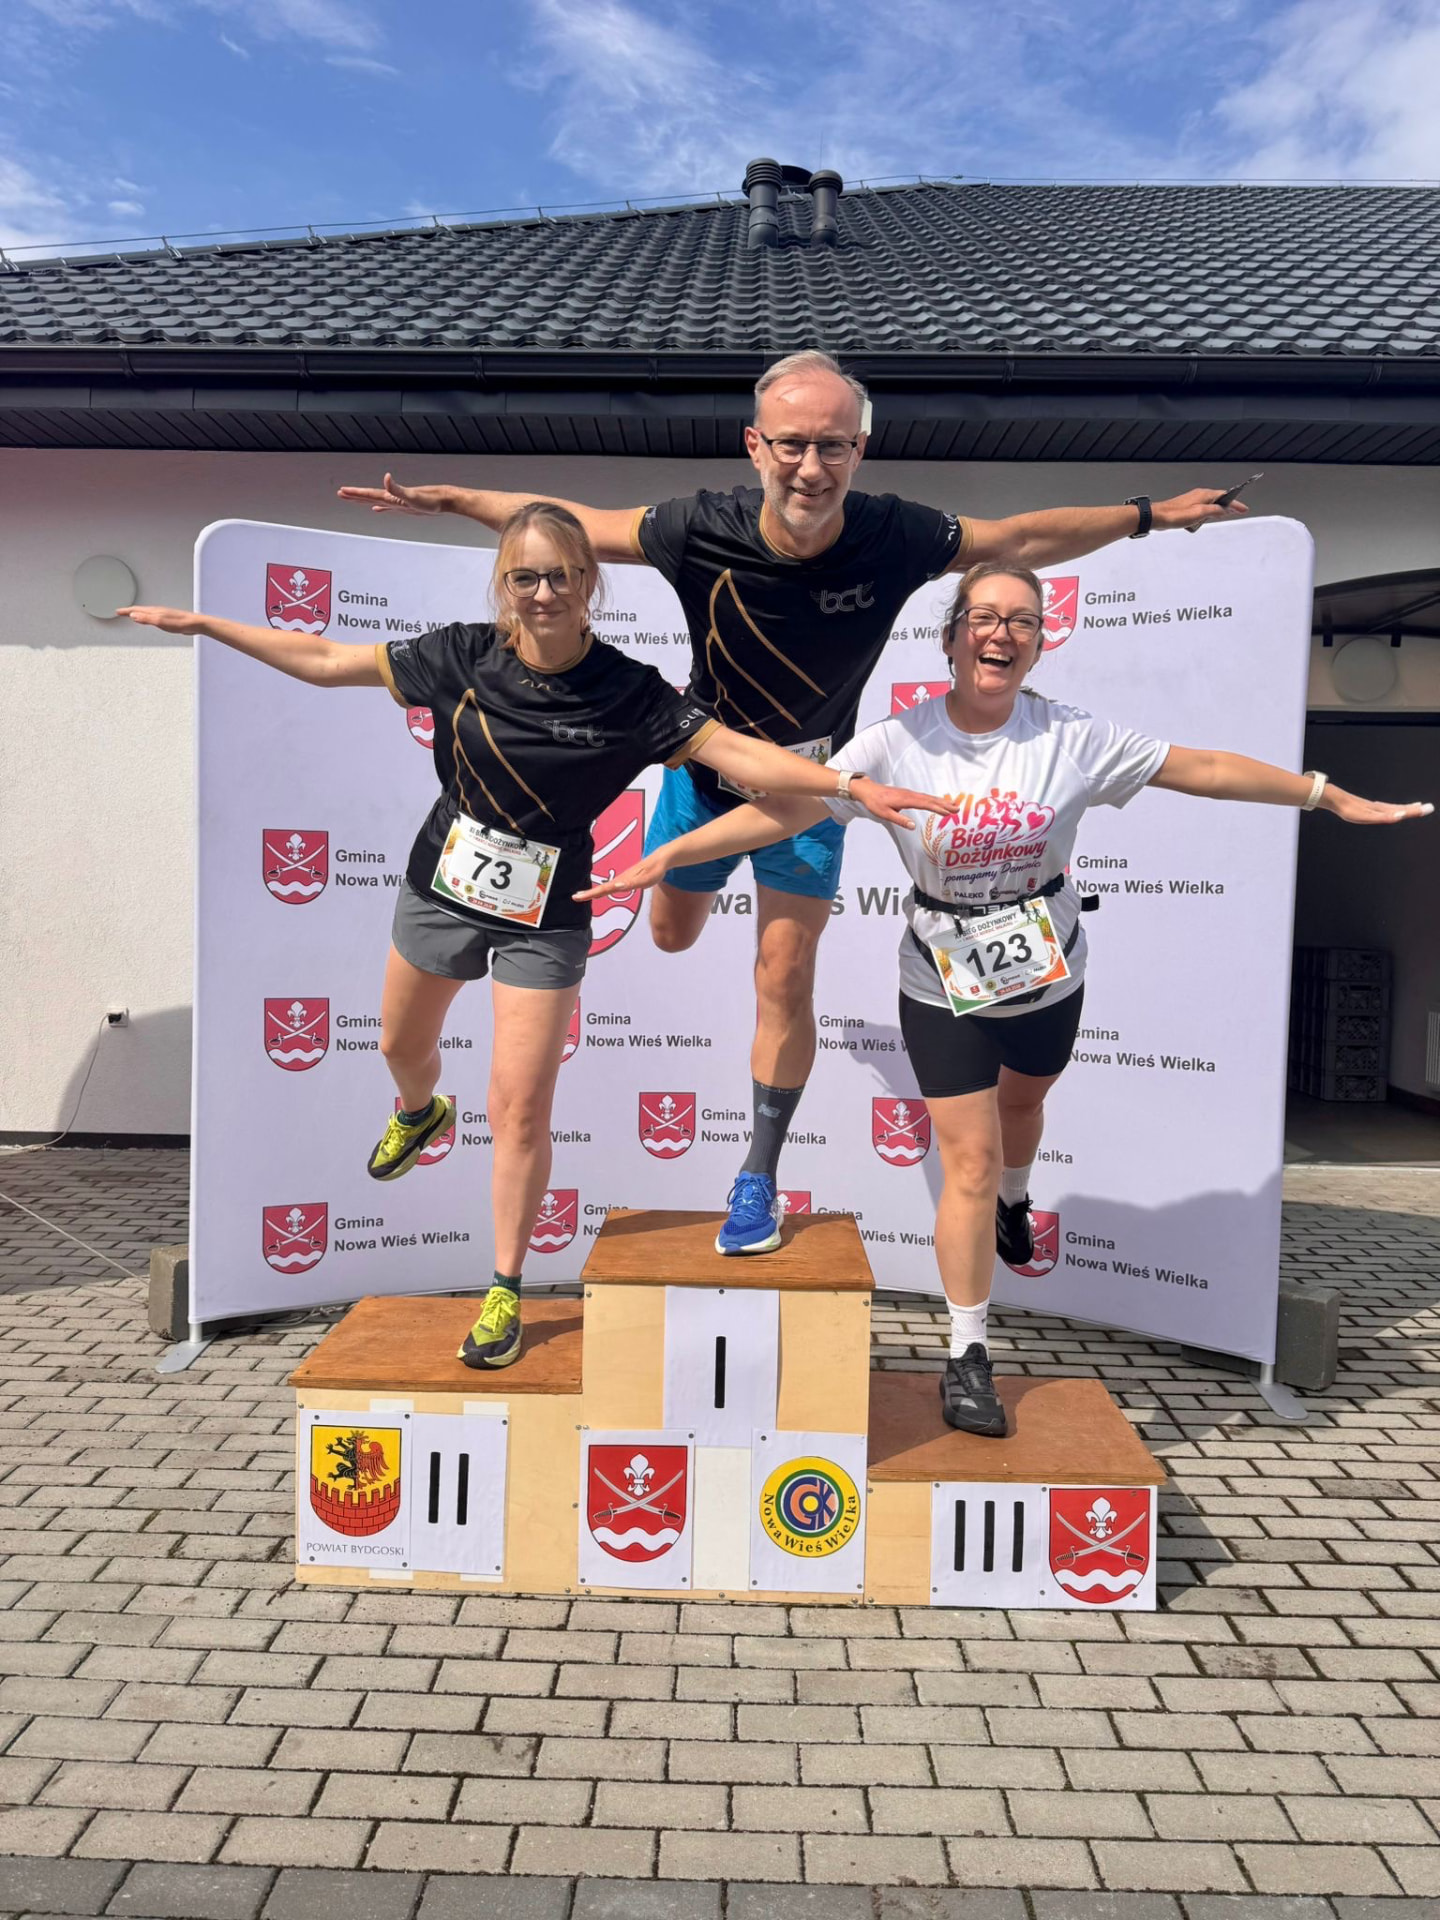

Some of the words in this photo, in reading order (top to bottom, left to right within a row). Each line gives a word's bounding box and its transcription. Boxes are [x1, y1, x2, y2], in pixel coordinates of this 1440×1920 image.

[338, 590, 388, 607] Gmina
[1084, 590, 1136, 605] Gmina
[338, 613, 380, 629] Nowa
[385, 618, 421, 633] Wieś
[592, 610, 637, 622] Gmina
[1083, 616, 1127, 629] Nowa
[1132, 609, 1171, 625] Wieś
[1176, 605, 1233, 621] Wielka
[634, 632, 668, 644] Wieś
[951, 828, 997, 850] Bieg
[336, 849, 386, 863] Gmina
[944, 840, 1048, 868] Dożynkowy
[1077, 855, 1128, 869] Gmina
[471, 851, 512, 890] 73
[336, 873, 378, 887] Nowa
[383, 874, 402, 887] Wi
[943, 870, 998, 886] pomagamy
[1076, 880, 1119, 893] Nowa
[1125, 880, 1164, 894] Wieś
[1169, 880, 1224, 894] Wielka
[966, 933, 1032, 977] 123
[586, 1012, 631, 1025] Gmina
[819, 1015, 865, 1028] Gmina
[336, 1039, 379, 1051] Nowa
[439, 1037, 472, 1049] ielka
[586, 1035, 624, 1047] Nowa
[629, 1034, 662, 1047] Wieś
[666, 1035, 712, 1047] Wielka
[819, 1037, 857, 1050] Nowa
[862, 1038, 896, 1051] Wieś
[1070, 1050, 1111, 1064] Nowa
[1116, 1052, 1155, 1067] Wieś
[1160, 1055, 1216, 1072] Wielka
[701, 1108, 746, 1120] Gmina
[462, 1133, 493, 1145] Now
[701, 1130, 739, 1142] Nowa
[1038, 1148, 1073, 1164] ielka
[334, 1216, 384, 1230] Gmina
[583, 1224, 602, 1236] No
[334, 1239, 376, 1252] Nowa
[381, 1234, 417, 1248] Wieś
[421, 1231, 470, 1244] Wielka
[861, 1230, 896, 1243] Wieś
[900, 1232, 935, 1246] Wiel
[1065, 1231, 1115, 1250] Gmina
[1065, 1253, 1107, 1271] Nowa
[1112, 1260, 1150, 1279] Wieś
[1155, 1268, 1208, 1289] Wielka
[763, 1493, 782, 1539] Nowa
[783, 1535, 823, 1552] Wieś
[824, 1495, 857, 1549] Wielka
[306, 1543, 347, 1553] POWIAT
[350, 1545, 404, 1556] BYDGOSKI
